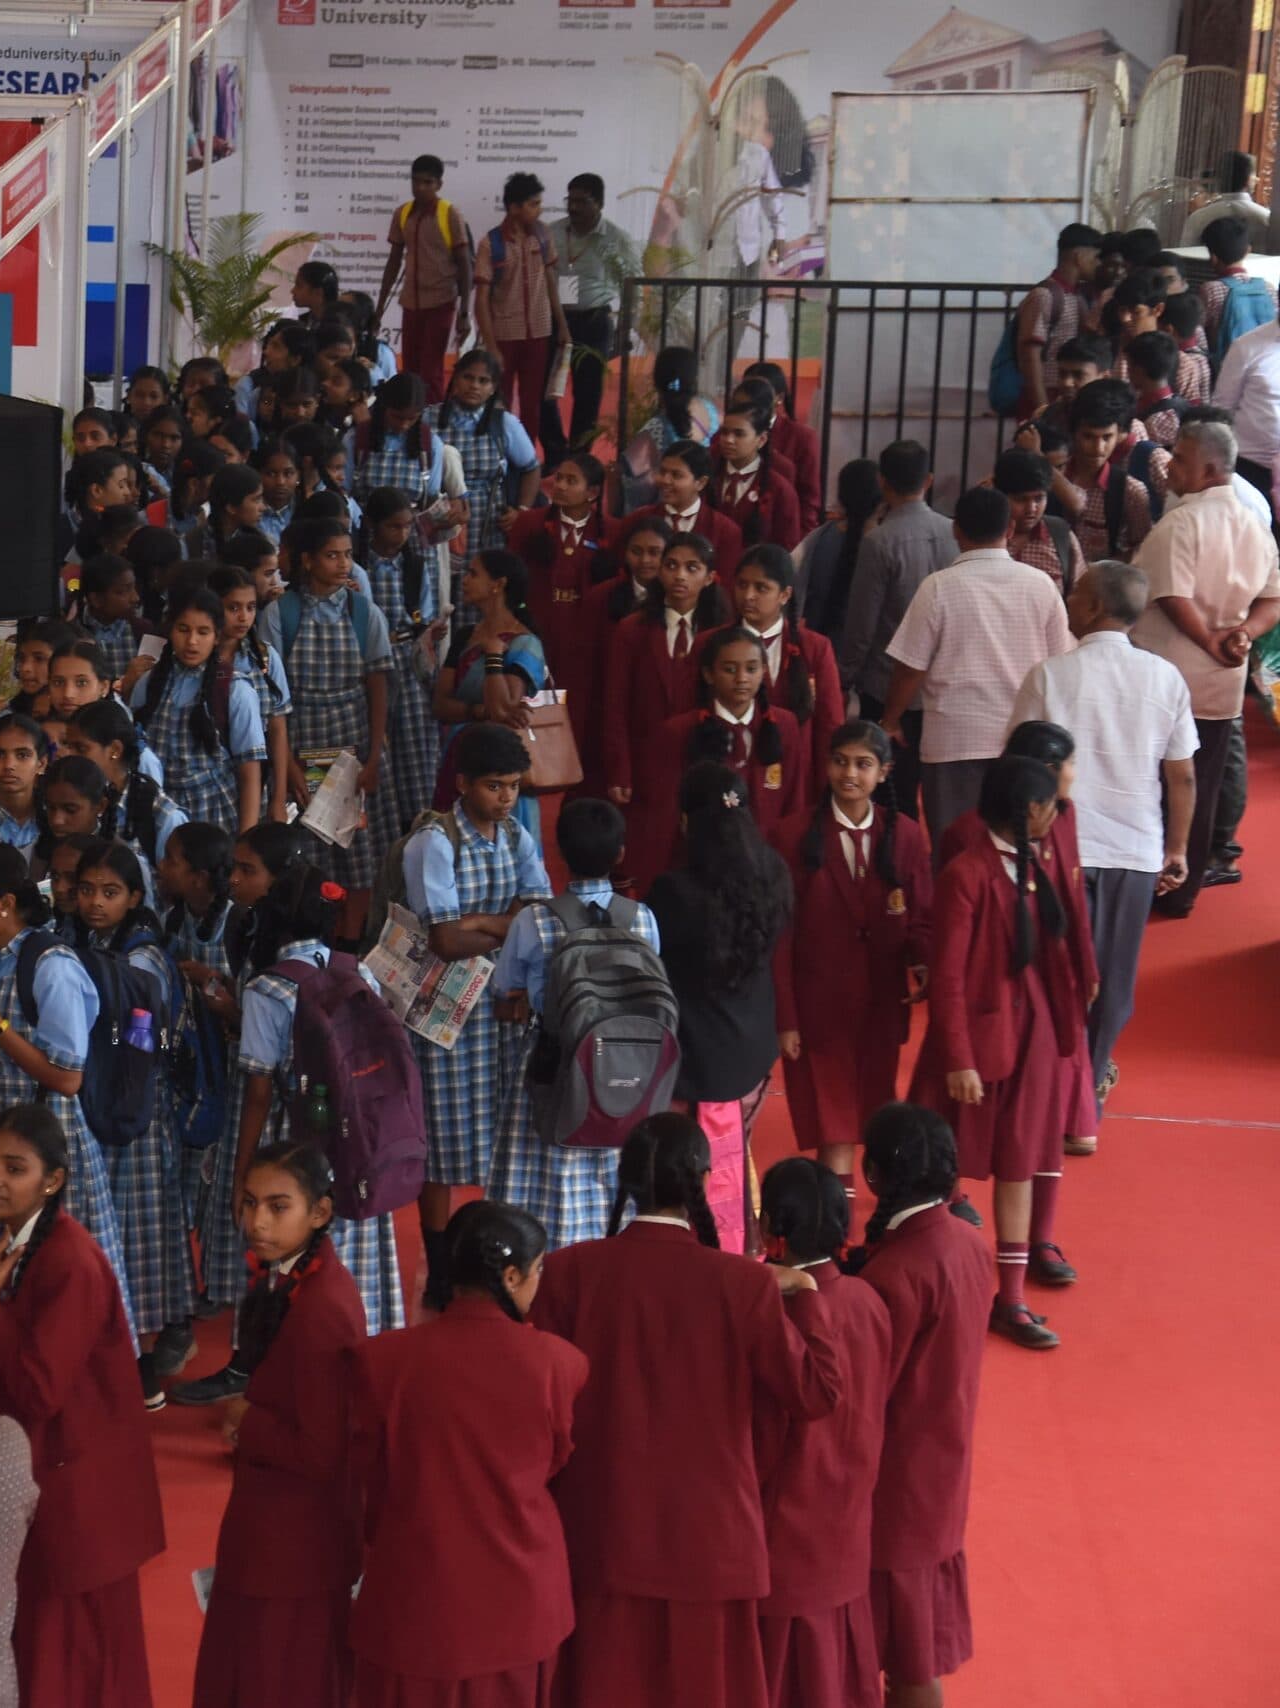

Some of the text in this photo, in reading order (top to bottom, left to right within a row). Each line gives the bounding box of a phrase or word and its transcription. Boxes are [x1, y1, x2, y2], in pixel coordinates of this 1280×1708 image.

[322, 8, 427, 28] University
[288, 84, 391, 96] Undergraduate Programs
